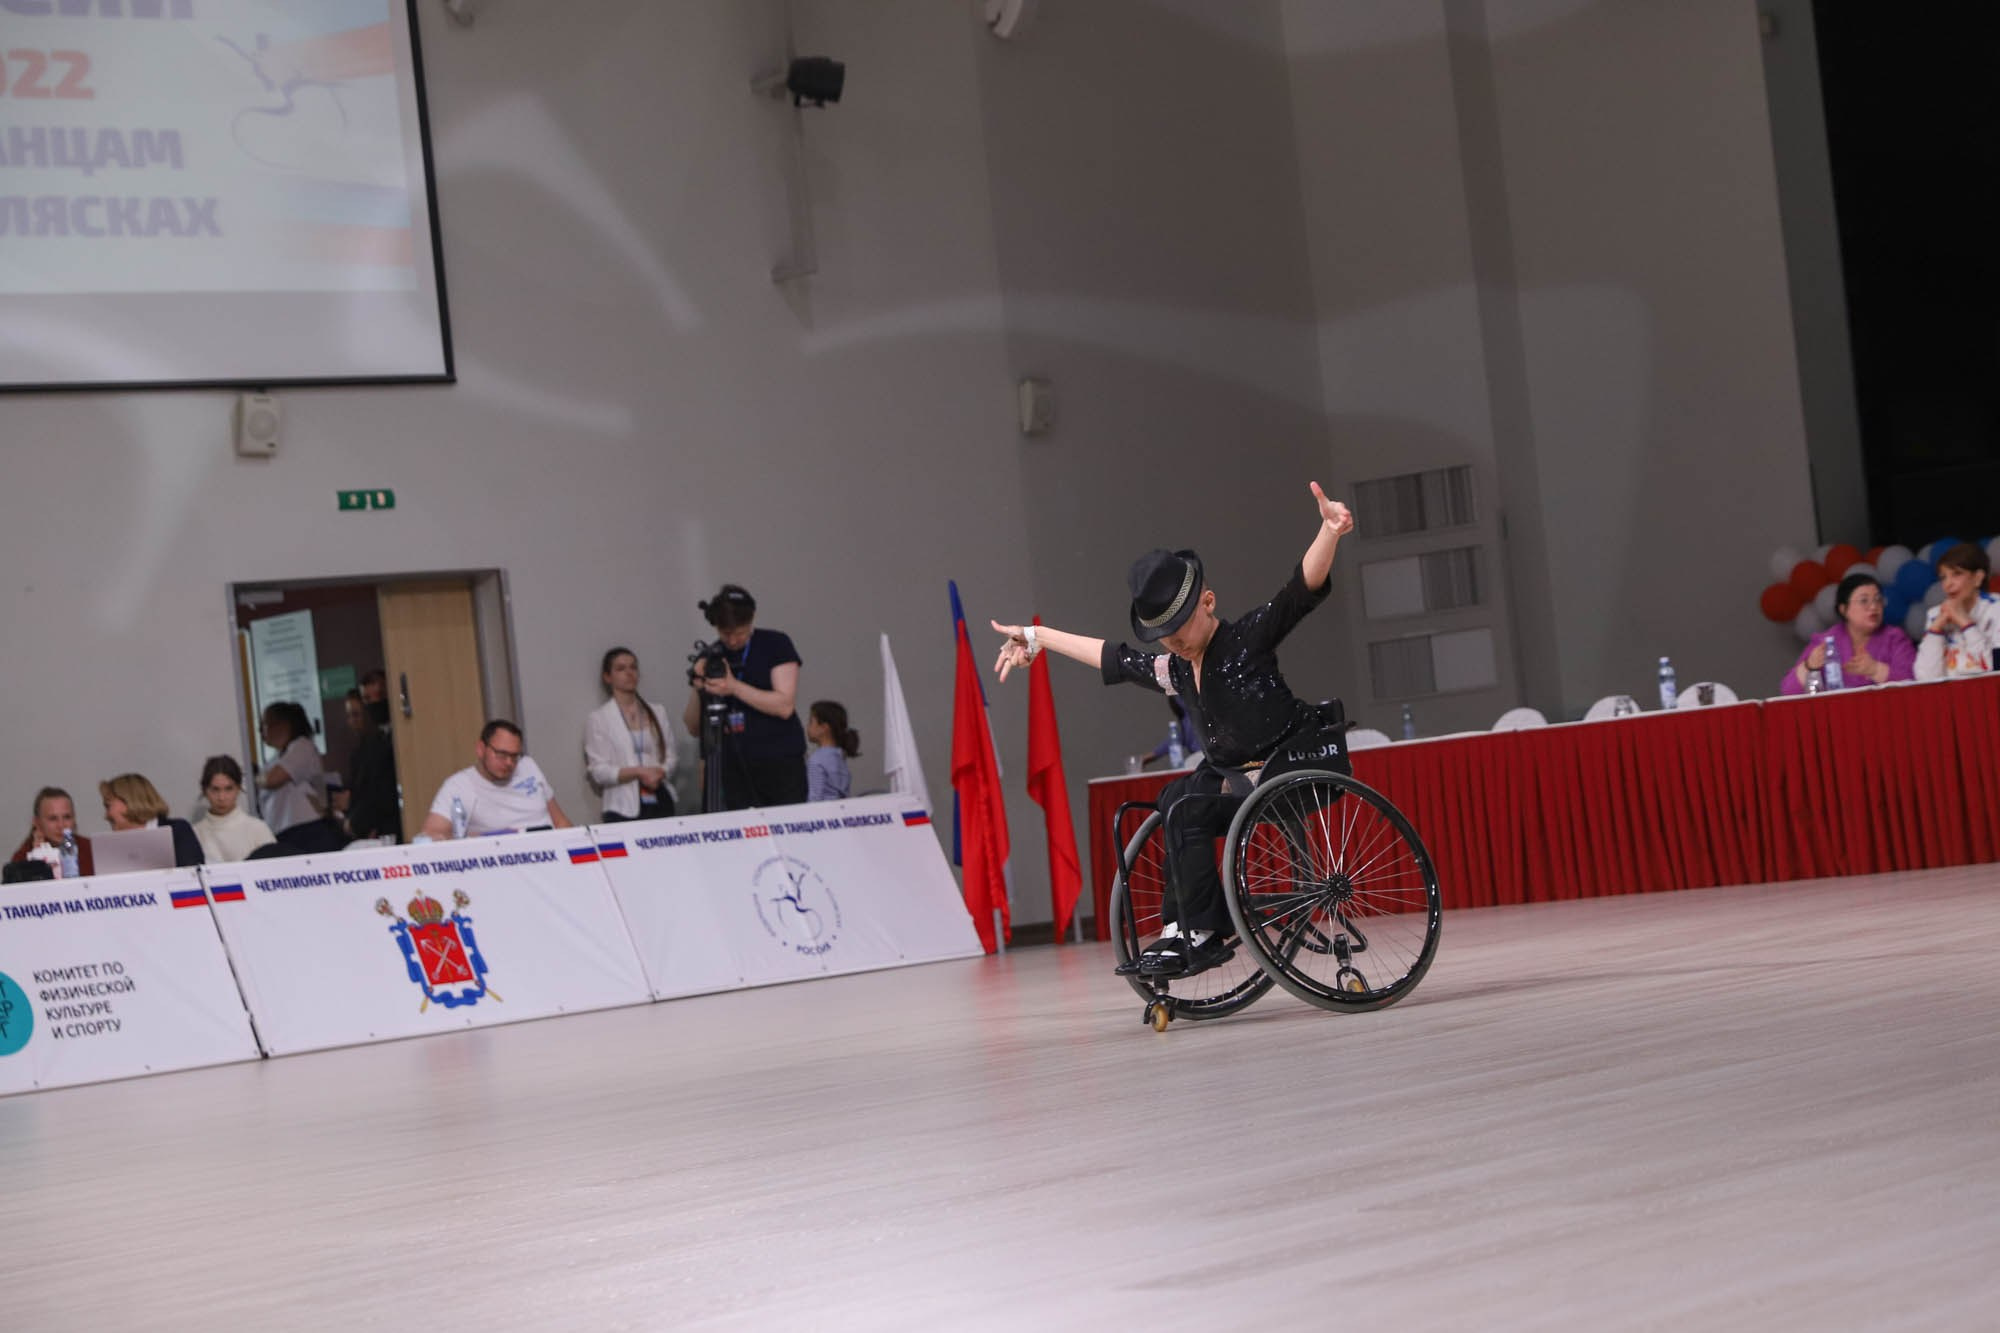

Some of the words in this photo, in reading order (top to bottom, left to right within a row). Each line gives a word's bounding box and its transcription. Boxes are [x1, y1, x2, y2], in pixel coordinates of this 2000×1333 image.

[0, 48, 96, 99] 22
[0, 127, 185, 176] НЦАМ
[635, 832, 701, 850] ЧЕМПИОНАТ
[702, 829, 743, 843] РОССИИ
[743, 825, 769, 839] 2022
[769, 824, 784, 835] ПО
[784, 820, 827, 834] ТАНЦАМ
[827, 818, 842, 829] НА
[255, 873, 332, 892] ЧЕМПИОНАТ
[333, 868, 381, 884] РОССИИ
[381, 864, 412, 880] 2022
[412, 862, 430, 876] ПО
[431, 858, 481, 874] ТАНЦАМ
[480, 856, 497, 869] НА
[499, 850, 558, 866] КОЛЯСКАХ
[3, 901, 63, 919] ТАНЦАМ
[64, 899, 85, 913] НА
[85, 893, 158, 911] КОЛЯСКАХ
[33, 963, 99, 984] КОМИТЕТ
[102, 961, 124, 975] ПО
[40, 976, 136, 1002] ФИЗИЧЕСКОЙ
[45, 1000, 113, 1021] КУЛЬТУРЕ
[51, 1026, 64, 1040] И
[66, 1019, 121, 1039] СПОРТУ
